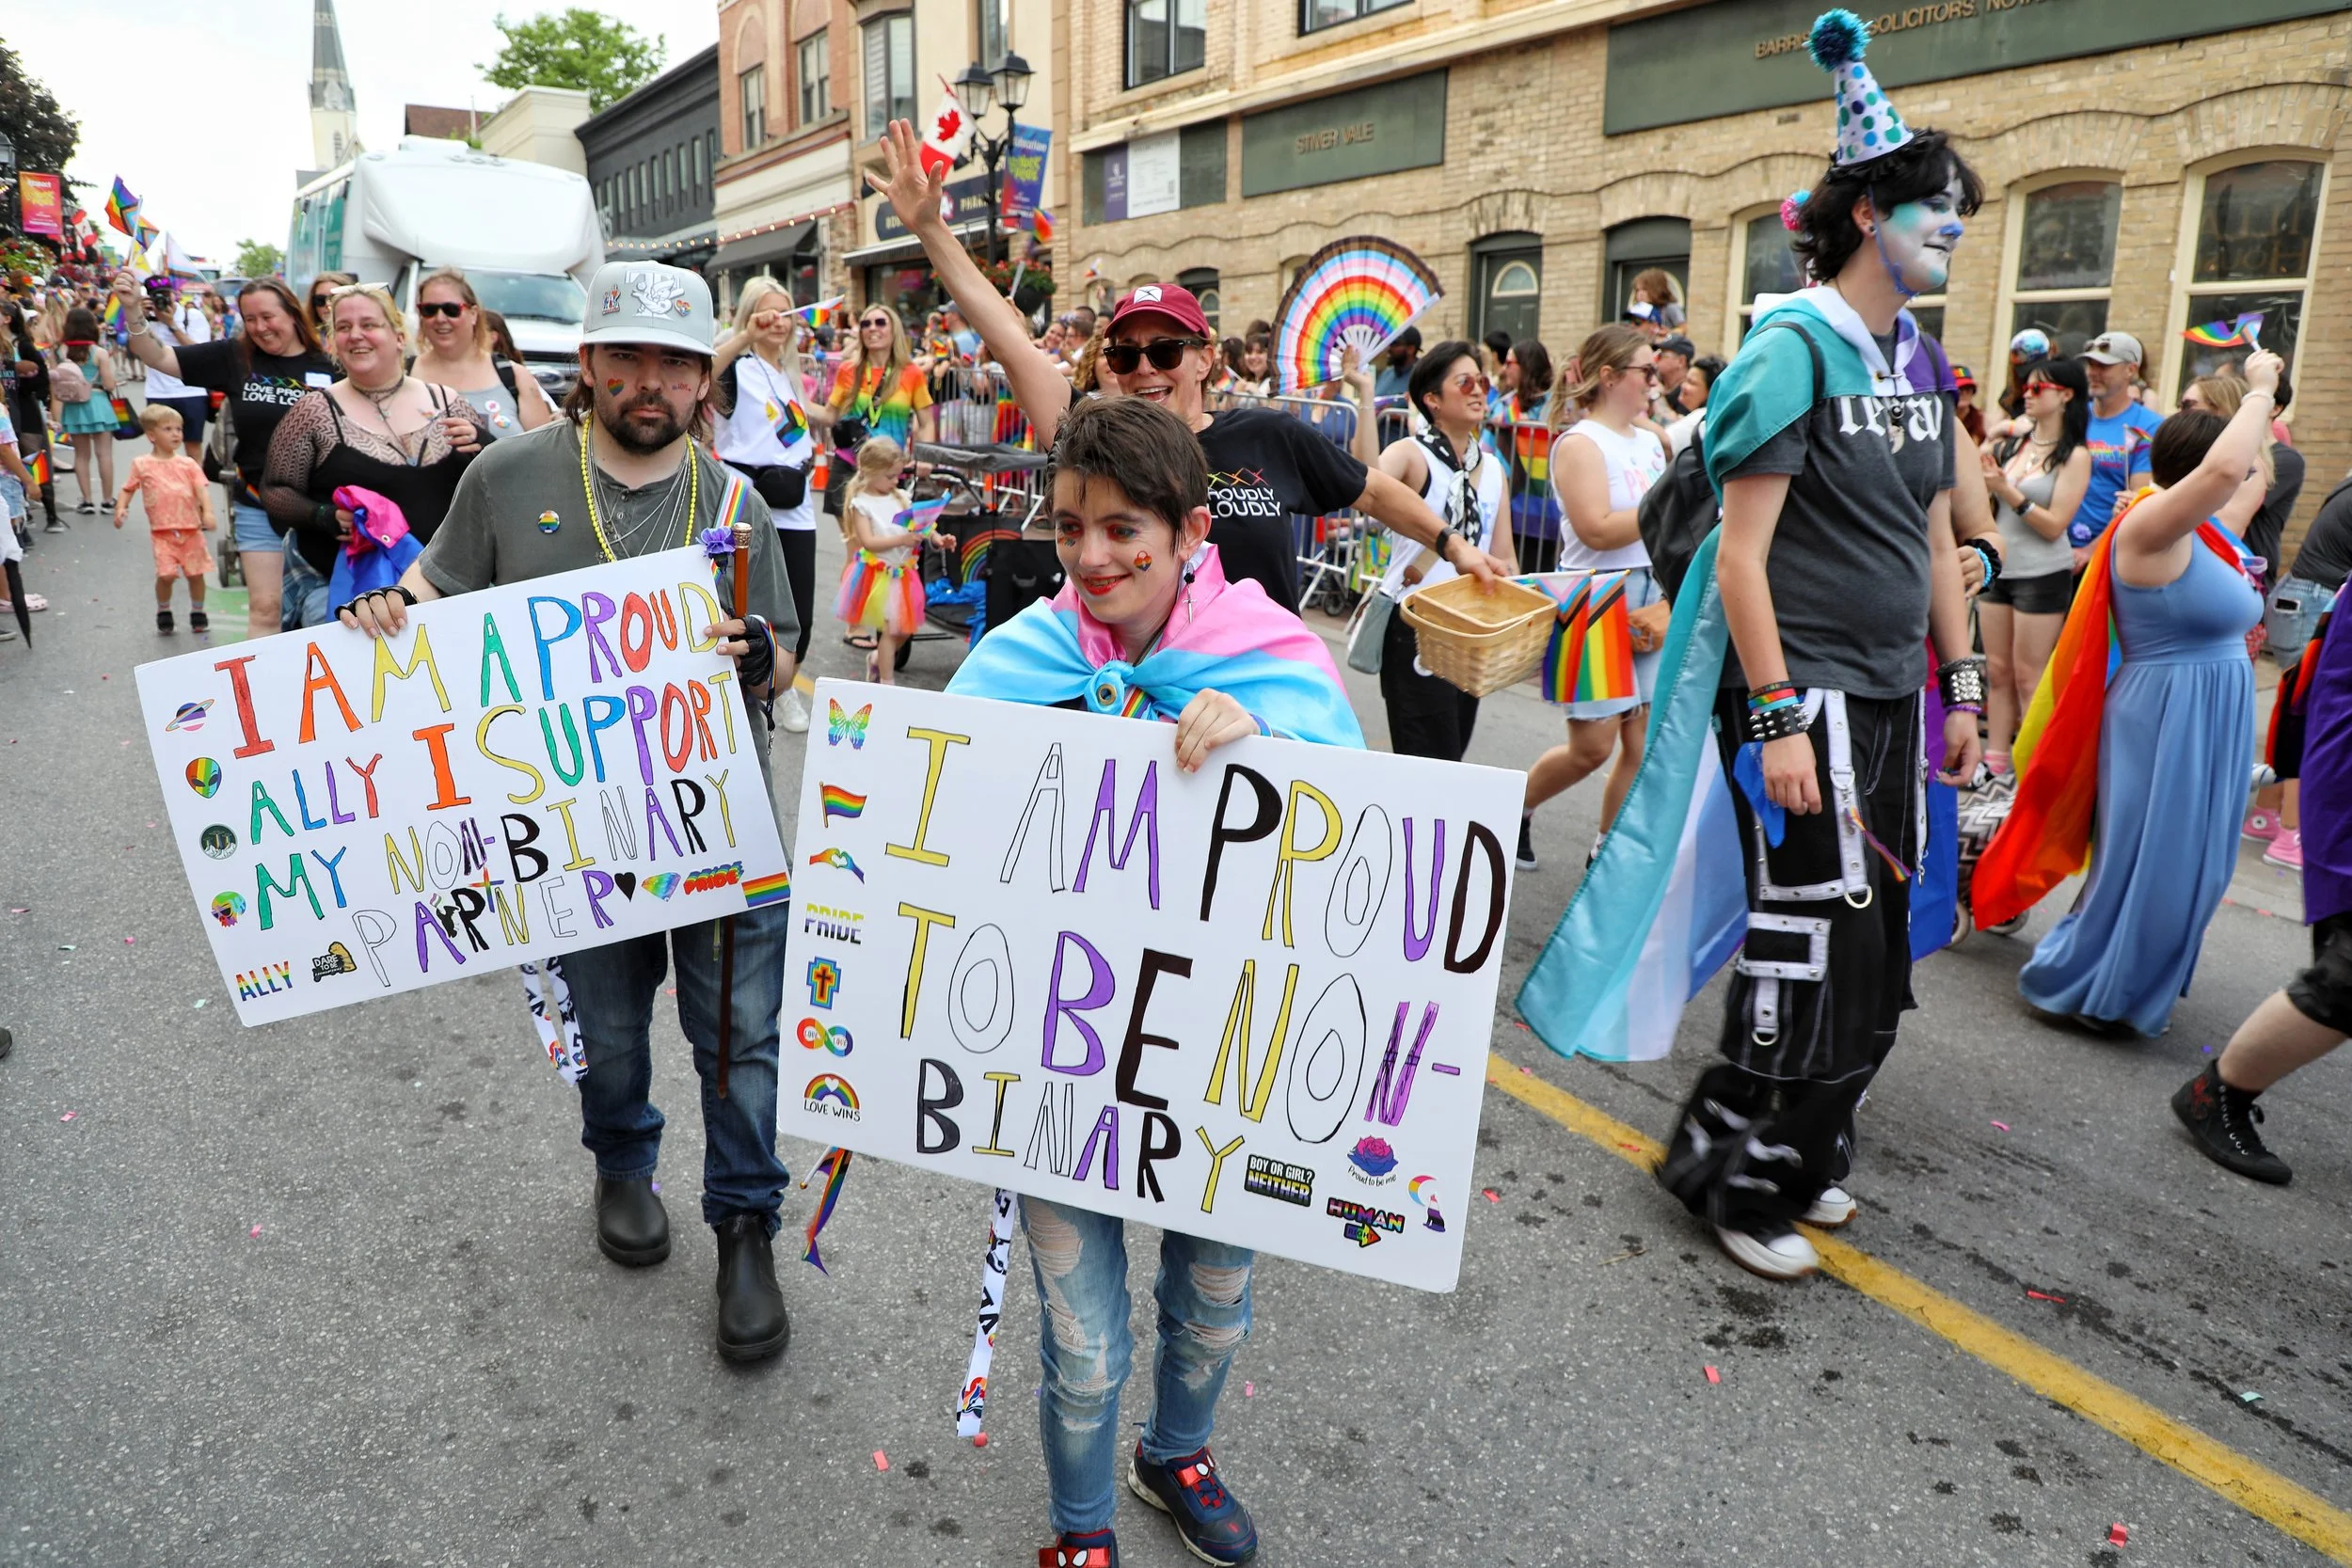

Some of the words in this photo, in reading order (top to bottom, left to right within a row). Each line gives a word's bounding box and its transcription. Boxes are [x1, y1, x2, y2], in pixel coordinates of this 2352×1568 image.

[1343, 121, 1375, 145] VALE
[243, 391, 277, 404] LOVE
[245, 382, 275, 394] LOVE
[1206, 501, 1280, 519] LOUDLY
[215, 655, 276, 759] I
[481, 612, 523, 707] A
[527, 582, 722, 701] PROUD
[250, 752, 383, 845] ALLY
[412, 722, 471, 810] I
[475, 670, 738, 804] SUPPORT
[255, 846, 348, 930] MY
[384, 768, 737, 895] NON-BINARY
[884, 725, 971, 867] I
[999, 742, 1160, 911] AM
[1200, 763, 1506, 974] PROUD
[683, 861, 744, 895] PRIDE
[804, 902, 865, 945] PRIDE
[313, 954, 339, 968] DARE
[235, 960, 294, 1002] ALLY
[898, 901, 1015, 1054] TO
[1041, 929, 1194, 1112] BE
[1203, 958, 1461, 1144] NON-
[803, 1099, 829, 1116] LOVE
[833, 1106, 861, 1122] WINS
[916, 1058, 1246, 1213] BINARY
[1248, 1170, 1311, 1203] NEITHER
[1250, 1156, 1269, 1173] BOY
[1270, 1162, 1283, 1177] OR
[1285, 1165, 1313, 1184] GIRL?
[1348, 1164, 1369, 1185] Proud
[1368, 1177, 1375, 1186] to
[1375, 1177, 1385, 1187] be
[1386, 1174, 1397, 1184] me
[1327, 1199, 1405, 1234] HUMAN
